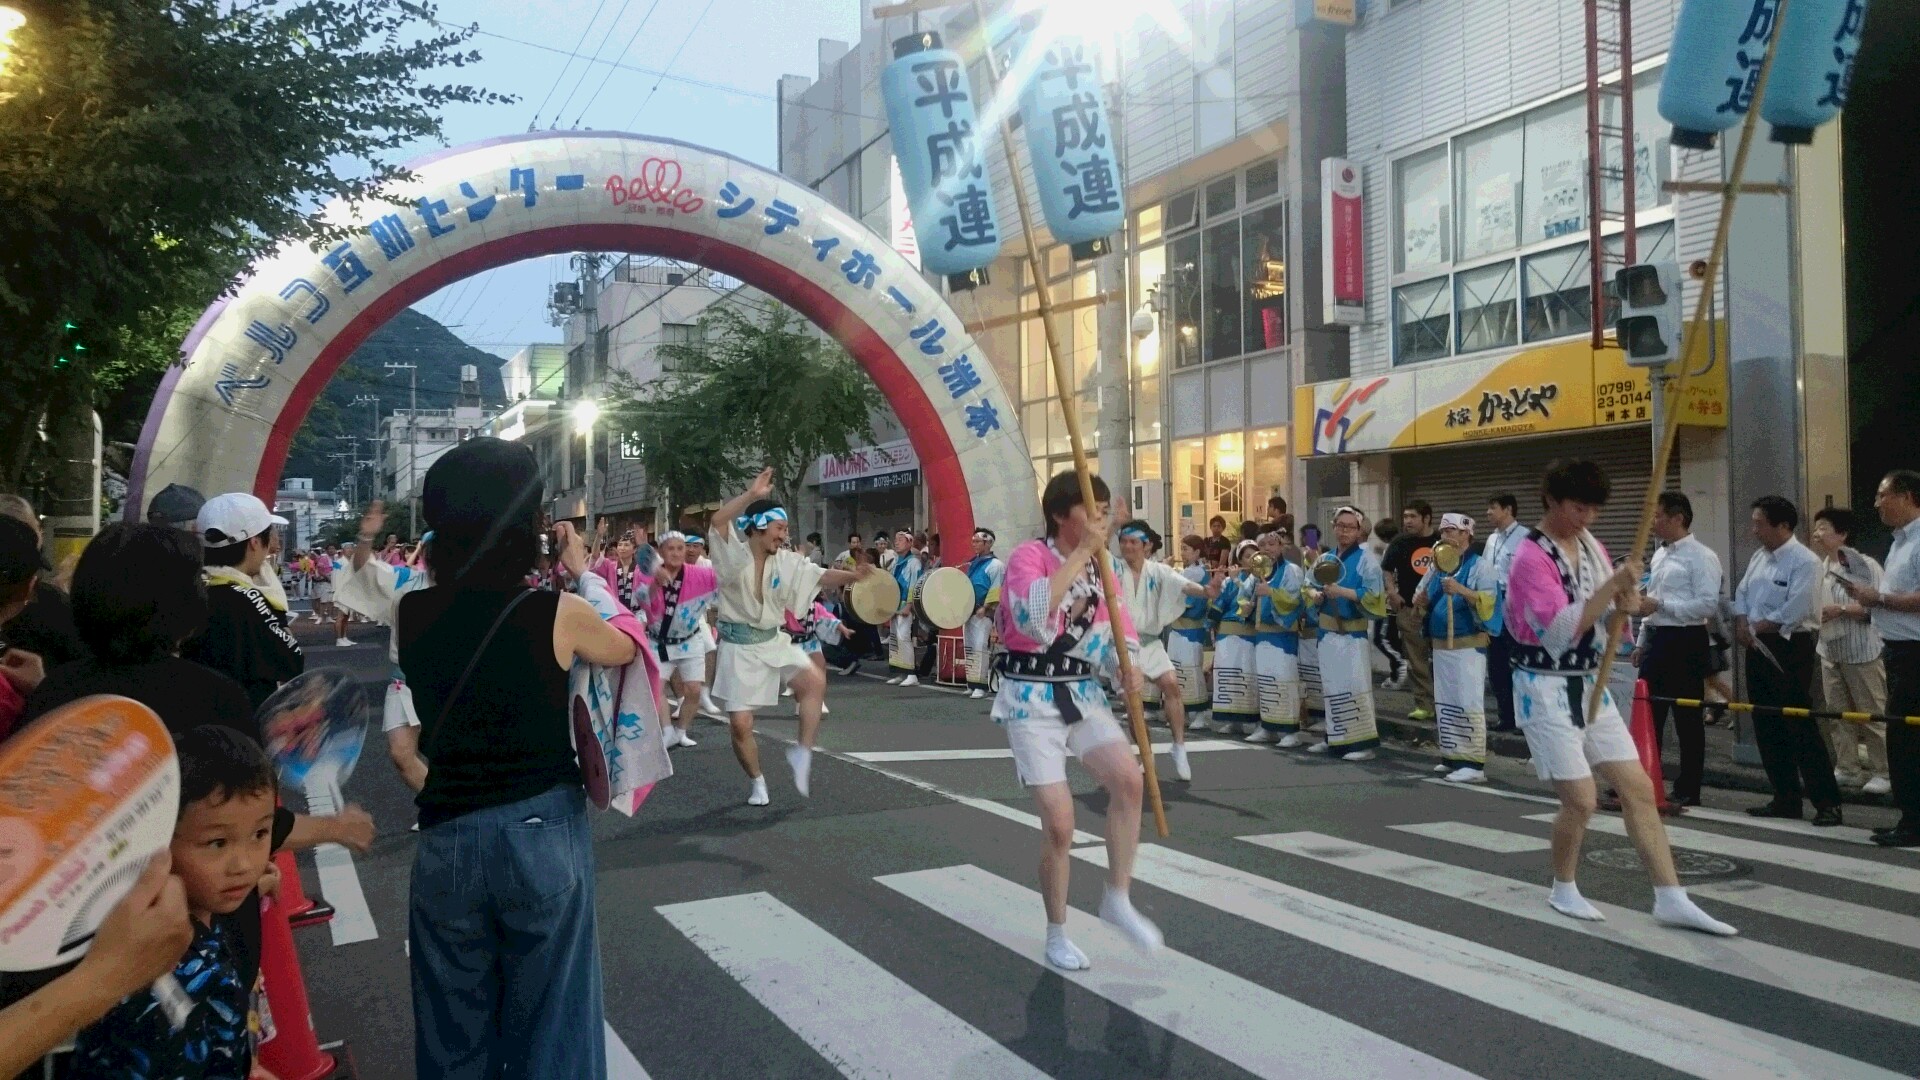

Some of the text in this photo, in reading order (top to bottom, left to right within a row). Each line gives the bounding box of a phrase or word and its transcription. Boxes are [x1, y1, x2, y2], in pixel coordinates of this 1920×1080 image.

[1040, 42, 1120, 220] 平成連
[911, 60, 997, 252] 平成連
[1597, 380, 1635, 396] (0799)
[1597, 390, 1652, 409] 23-0144
[1445, 384, 1558, 427] 本家 かまどや
[1606, 406, 1645, 422] 洲本店
